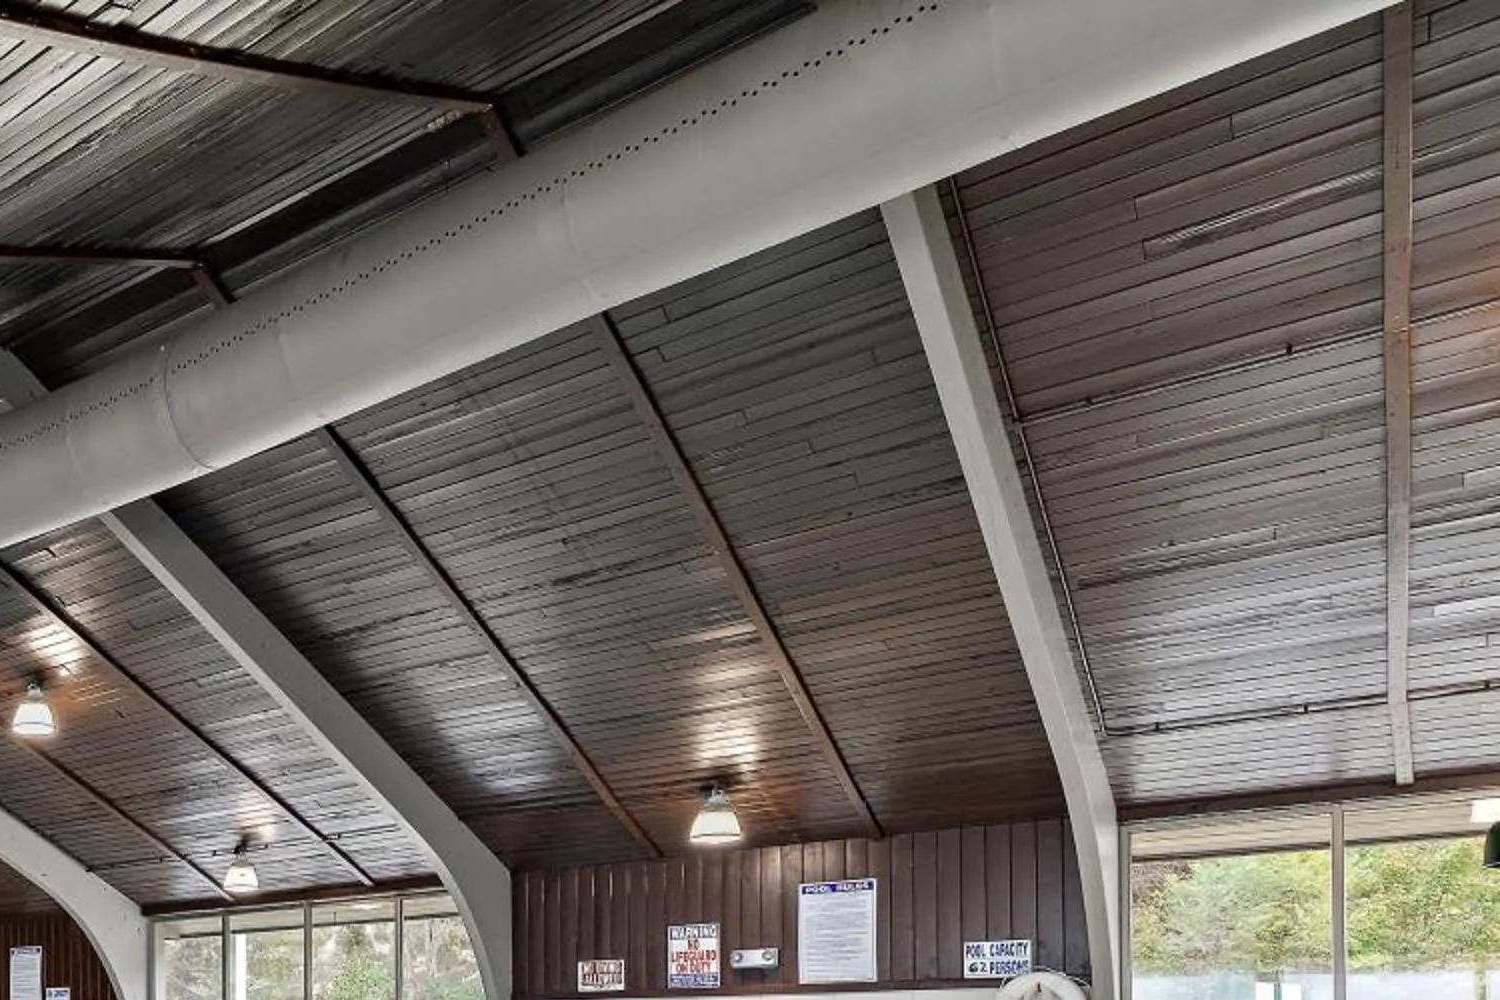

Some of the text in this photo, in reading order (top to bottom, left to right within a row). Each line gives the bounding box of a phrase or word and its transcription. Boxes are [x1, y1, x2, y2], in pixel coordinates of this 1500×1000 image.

[670, 926, 718, 940] WARNING
[687, 938, 700, 950] NO
[966, 942, 1029, 958] POOL CAPACITY
[671, 950, 717, 962] LIFEGUARD
[969, 961, 988, 973] 62
